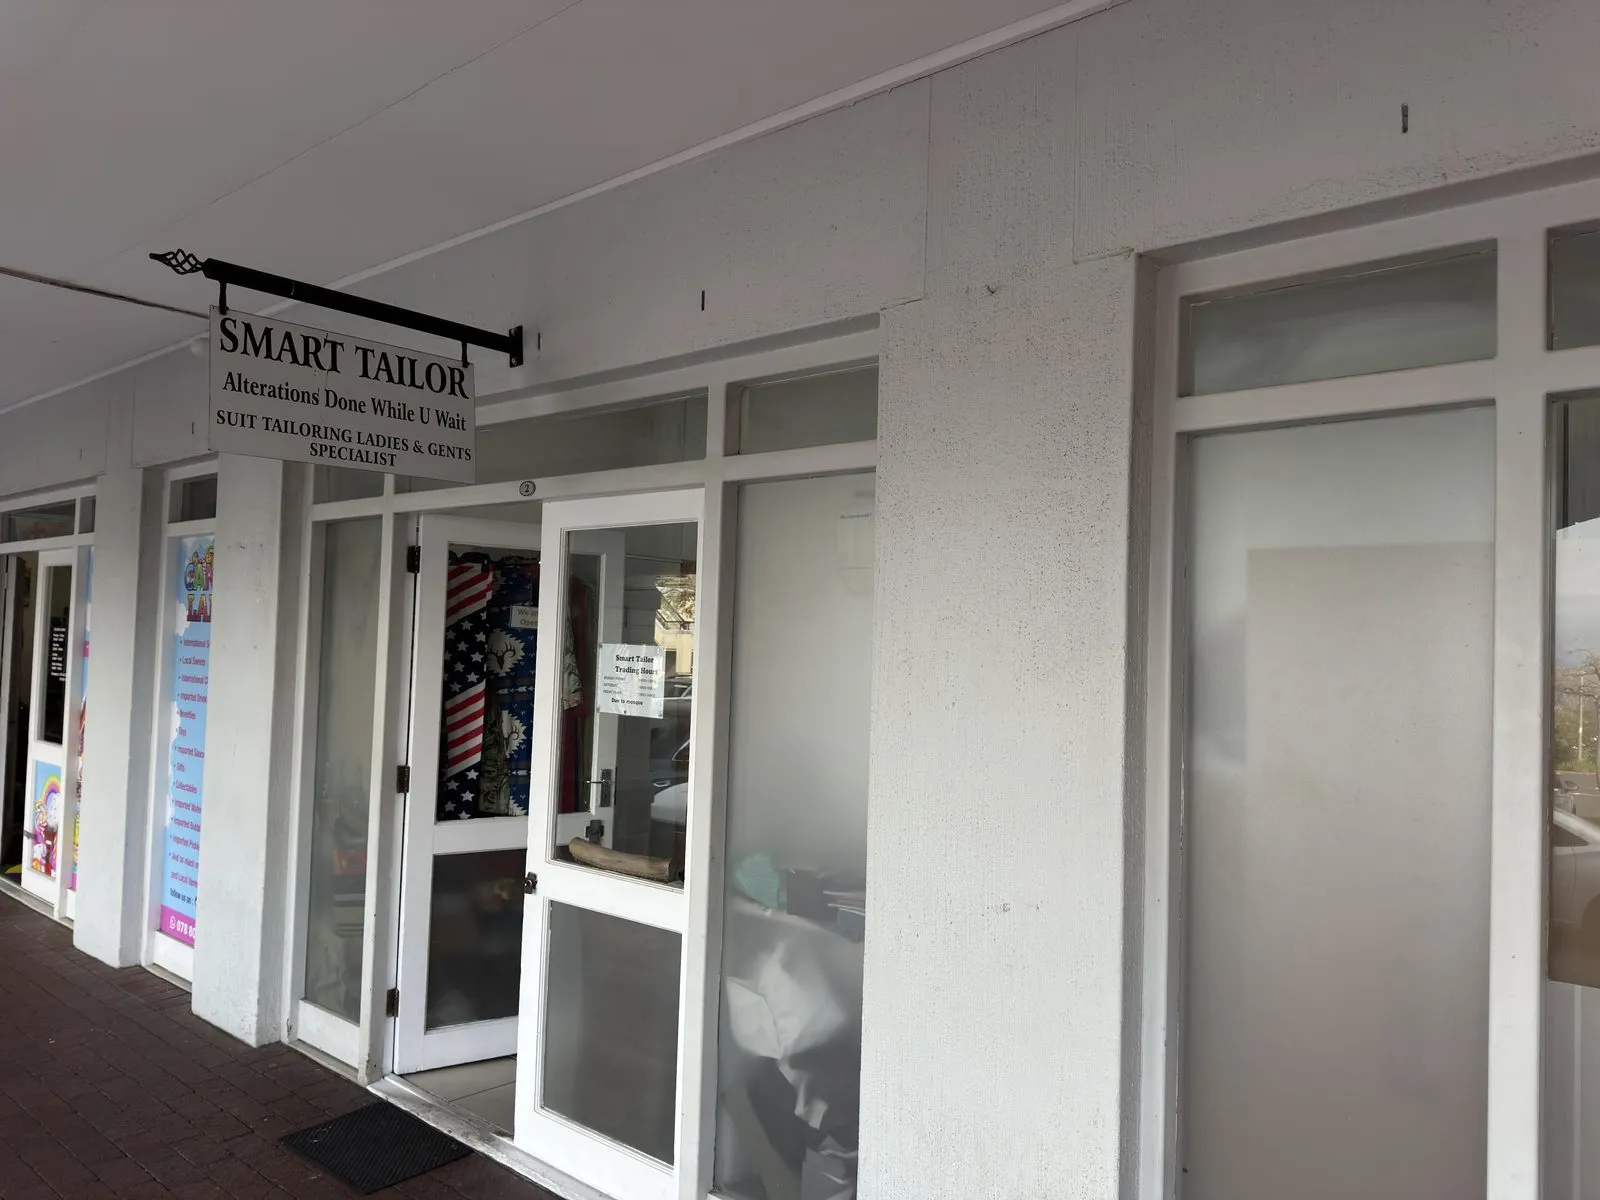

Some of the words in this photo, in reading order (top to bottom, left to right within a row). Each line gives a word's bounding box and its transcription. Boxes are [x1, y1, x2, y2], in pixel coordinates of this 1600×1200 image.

[219, 317, 345, 374] SMART
[354, 345, 470, 400] TAILOR
[222, 371, 320, 406] Alterations
[324, 388, 367, 414] Done
[370, 397, 416, 422] While
[418, 406, 431, 425] U
[434, 409, 467, 432] Wait
[216, 409, 257, 429] SUIT
[262, 416, 352, 443] TAILORING
[356, 431, 409, 451] LADIES
[412, 440, 425, 453] &
[427, 442, 472, 462] GENTS
[309, 442, 397, 467] SPECIALIST
[615, 654, 635, 662] Smart
[635, 655, 654, 663] Tailor
[615, 665, 640, 675] Trading
[176, 919, 188, 935] 078
